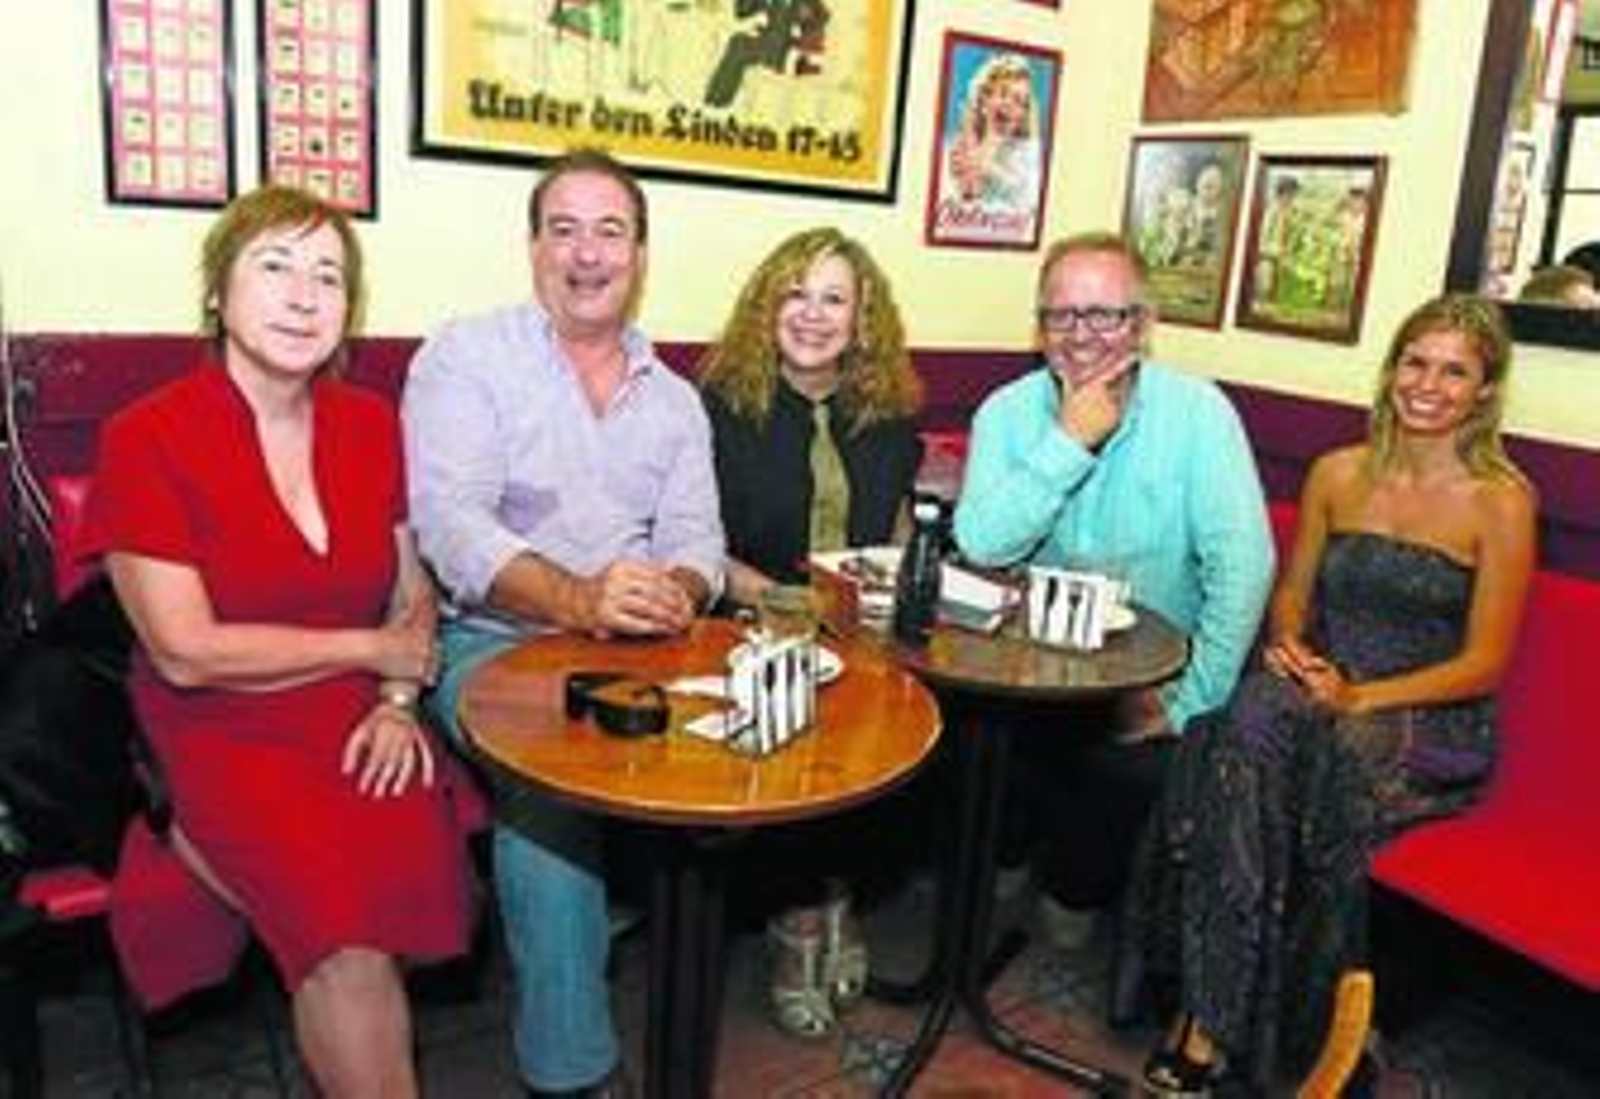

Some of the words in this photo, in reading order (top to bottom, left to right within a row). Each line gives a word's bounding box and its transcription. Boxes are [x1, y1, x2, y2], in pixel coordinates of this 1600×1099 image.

[469, 79, 583, 128] Unter
[591, 95, 654, 136] den
[662, 103, 777, 151] Linden
